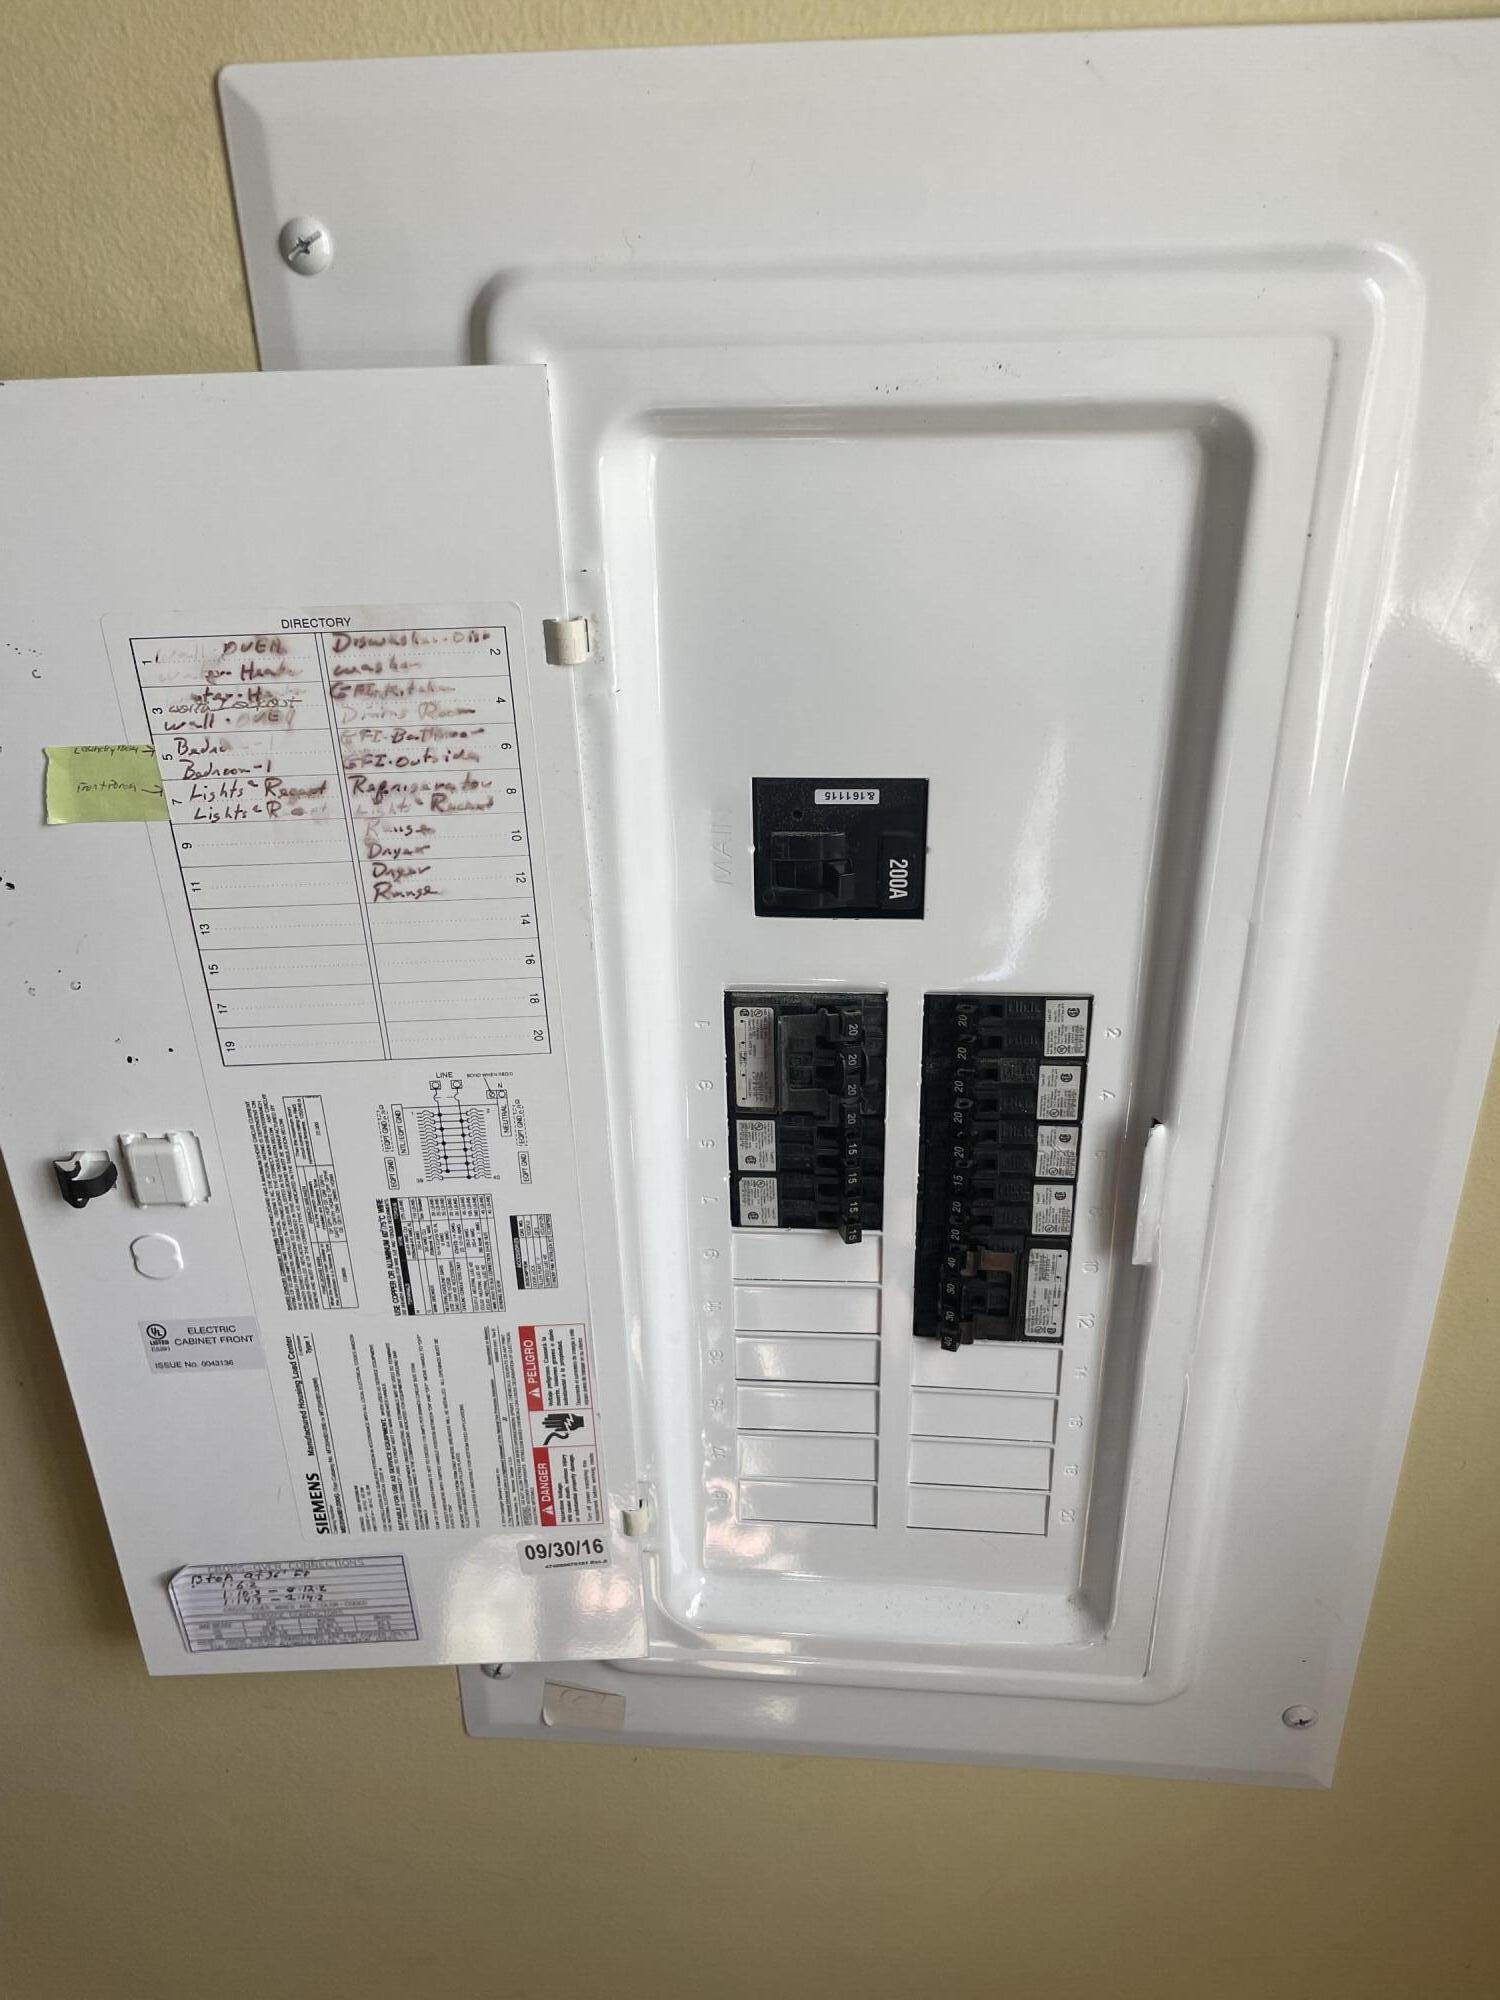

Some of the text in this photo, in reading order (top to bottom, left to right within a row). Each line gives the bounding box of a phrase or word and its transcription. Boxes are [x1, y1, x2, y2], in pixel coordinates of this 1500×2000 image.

[281, 617, 351, 629] DIRECTORY
[511, 830, 522, 842] 10
[515, 872, 526, 883] 12
[888, 859, 909, 900] 200A
[191, 882, 201, 892] 11
[520, 913, 531, 925] 14
[200, 924, 210, 935] 13
[525, 954, 535, 965] 16
[209, 964, 219, 974] 15
[530, 993, 540, 1004] 18
[218, 1003, 228, 1014] 17
[958, 1015, 968, 1027] 20
[533, 1029, 543, 1042] 20
[849, 1024, 858, 1036] 20
[1104, 1027, 1122, 1039] 2
[226, 1041, 235, 1052] 19
[958, 1047, 967, 1060] 20
[848, 1054, 857, 1066] 20
[848, 1084, 857, 1095] 20
[954, 1080, 964, 1093] 20
[847, 1113, 856, 1125] 20
[954, 1112, 963, 1124] 20
[849, 1144, 858, 1155] 15
[954, 1147, 964, 1159] 20
[848, 1173, 857, 1184] 15
[849, 1201, 858, 1213] 15
[952, 1201, 961, 1213] 20
[849, 1229, 857, 1241] 15
[951, 1229, 960, 1241] 20
[382, 1239, 397, 1270] ALUMINUM
[388, 1279, 402, 1304] COPPER
[392, 1305, 400, 1316] USE
[187, 1325, 236, 1334] ELECTRIC
[174, 1335, 254, 1346] CABINET FRONT
[304, 1340, 313, 1354] Type
[155, 1361, 182, 1369] ISSUE
[524, 1339, 537, 1384] PELIGRO
[284, 1335, 315, 1456] Manufactured Housing Load Center
[386, 1451, 396, 1474] SERVICE
[538, 1462, 551, 1502] DANGER
[391, 1483, 399, 1494] USE
[305, 1472, 330, 1535] SIEMENS
[393, 1507, 404, 1531] SUITABLE
[525, 1538, 604, 1560] 09/30/16
